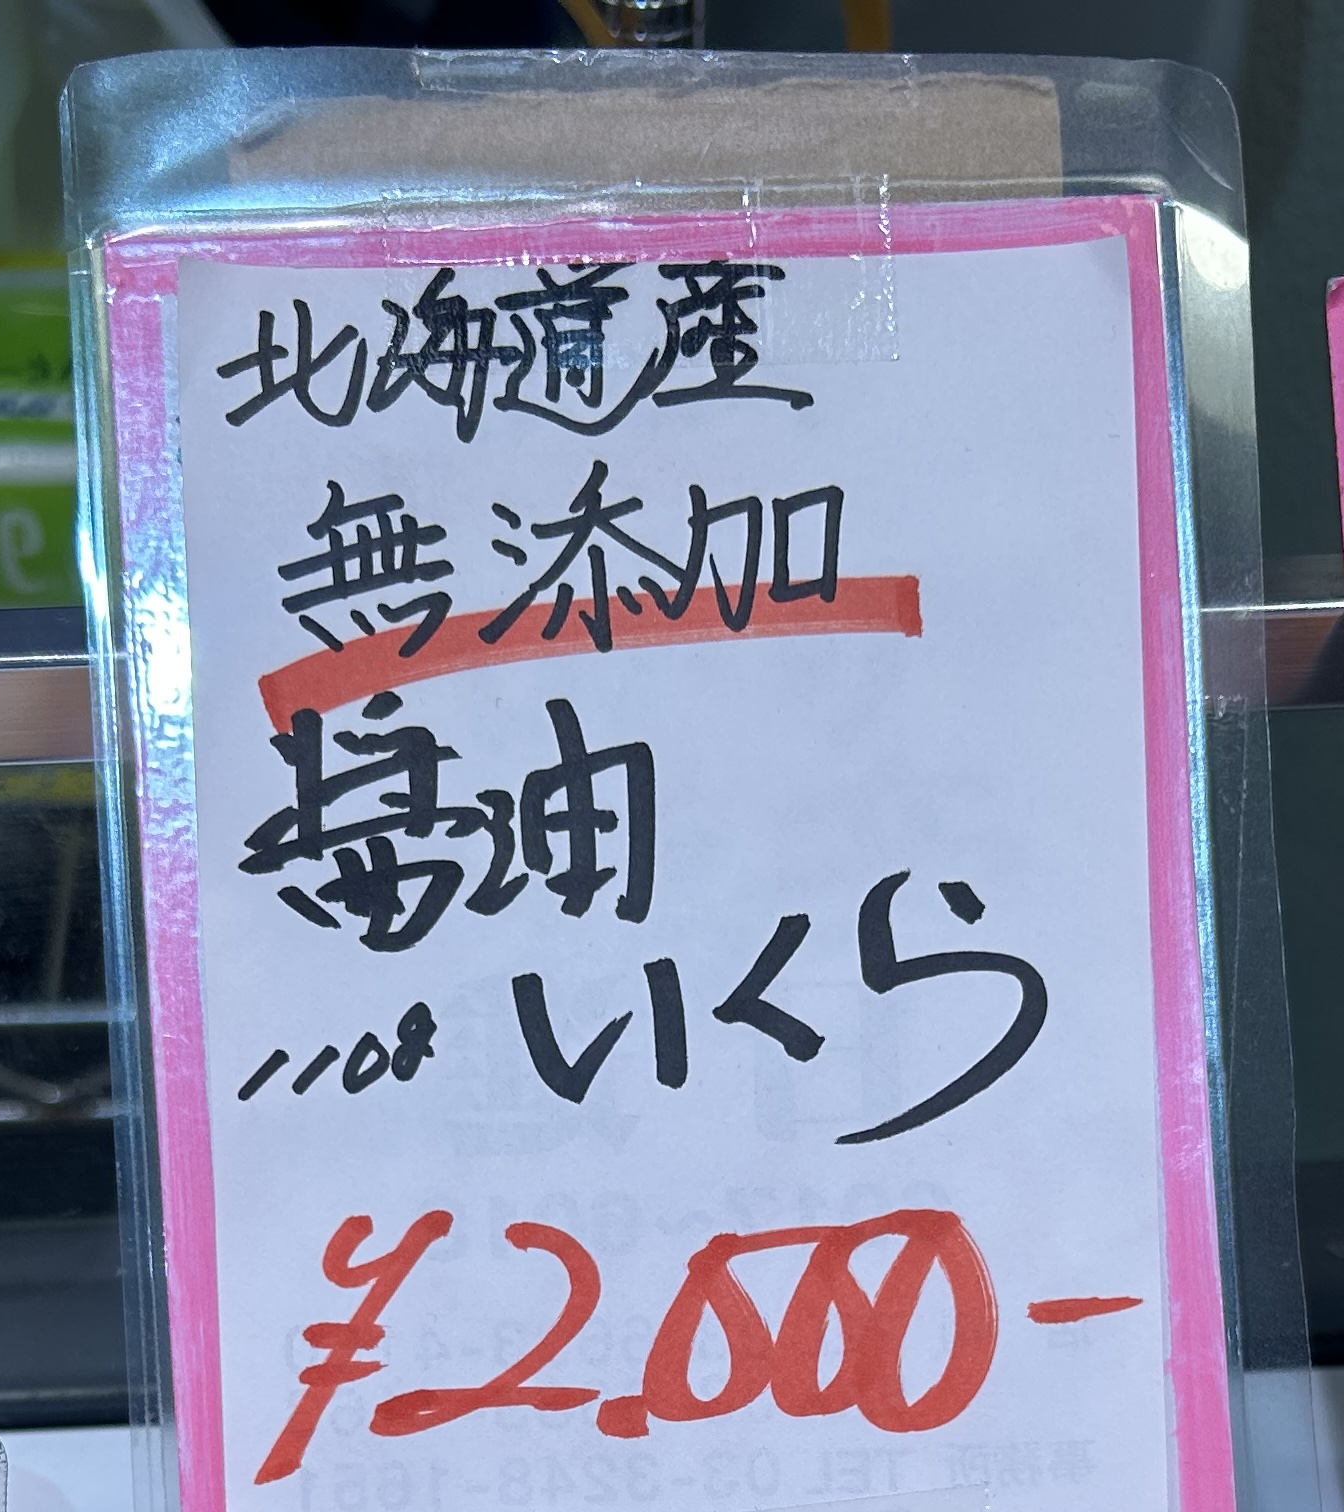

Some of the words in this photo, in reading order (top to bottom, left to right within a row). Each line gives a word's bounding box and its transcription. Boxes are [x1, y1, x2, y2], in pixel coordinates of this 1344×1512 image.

[217, 262, 814, 443] 北海道産
[278, 459, 846, 658] 無添加
[511, 869, 1049, 1146] いくら
